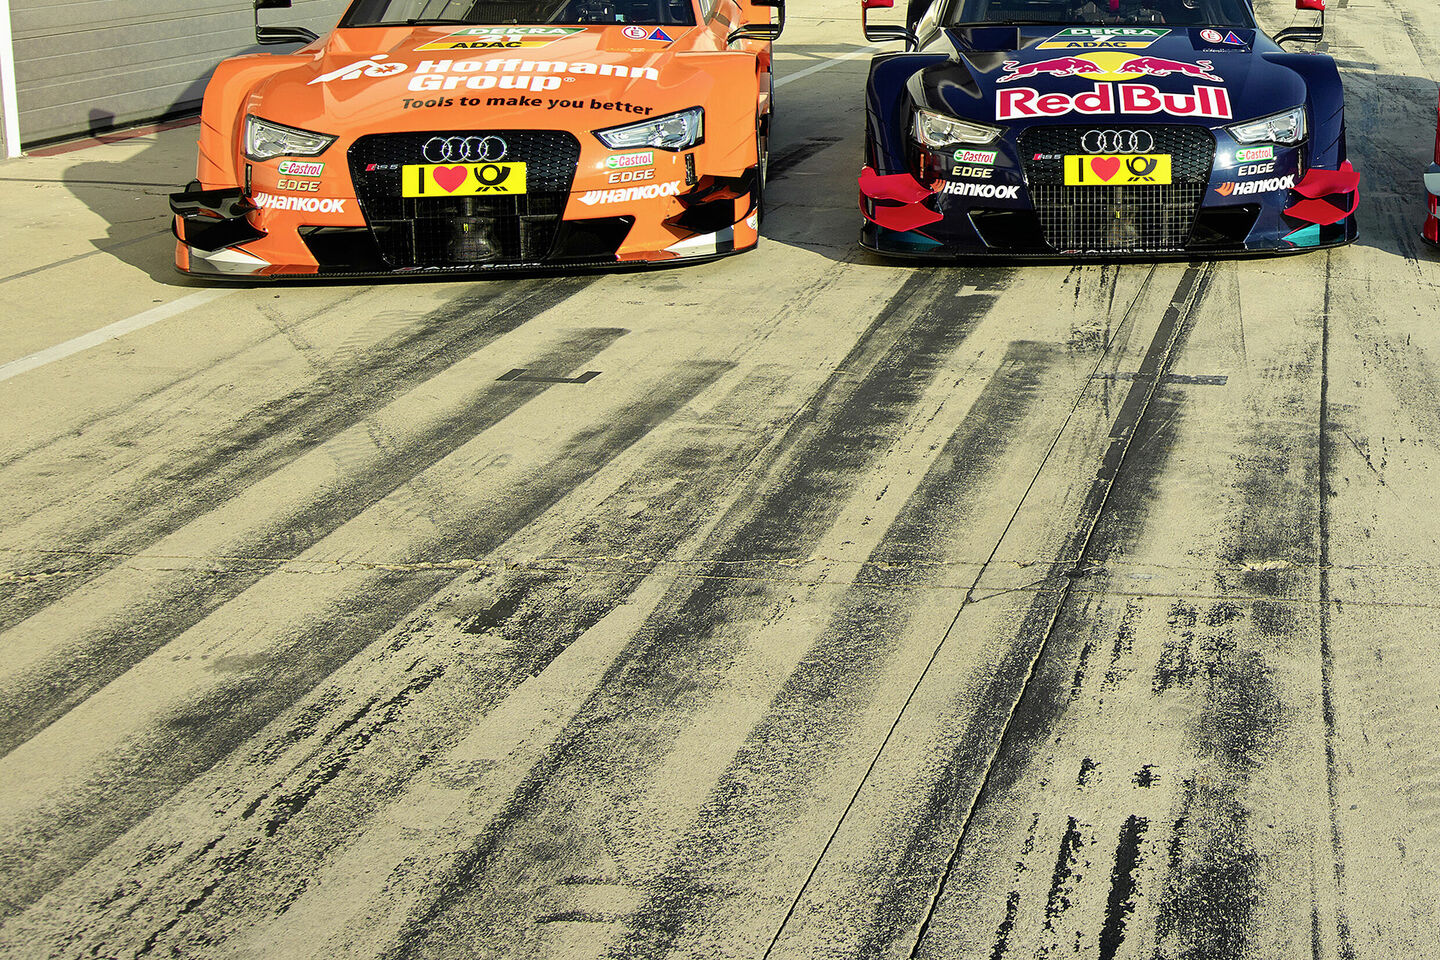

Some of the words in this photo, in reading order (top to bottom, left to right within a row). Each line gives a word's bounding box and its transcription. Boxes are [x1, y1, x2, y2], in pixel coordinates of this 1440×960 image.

[415, 58, 659, 81] Hoffmann
[402, 96, 453, 110] Tools
[459, 96, 482, 107] to
[486, 96, 543, 107] make
[548, 99, 584, 110] you
[590, 99, 653, 116] better
[999, 83, 1112, 118] Red
[1121, 84, 1230, 118] Bull
[619, 154, 652, 168] Castrol
[963, 151, 993, 163] Castrol
[1245, 150, 1272, 161] Castrol
[288, 162, 321, 175] Castrol
[952, 166, 994, 179] EDGE
[1078, 157, 1084, 182] I
[1238, 162, 1275, 176] EDGE
[418, 167, 425, 194] I
[608, 169, 656, 184] EDGE
[276, 179, 322, 192] EDGE
